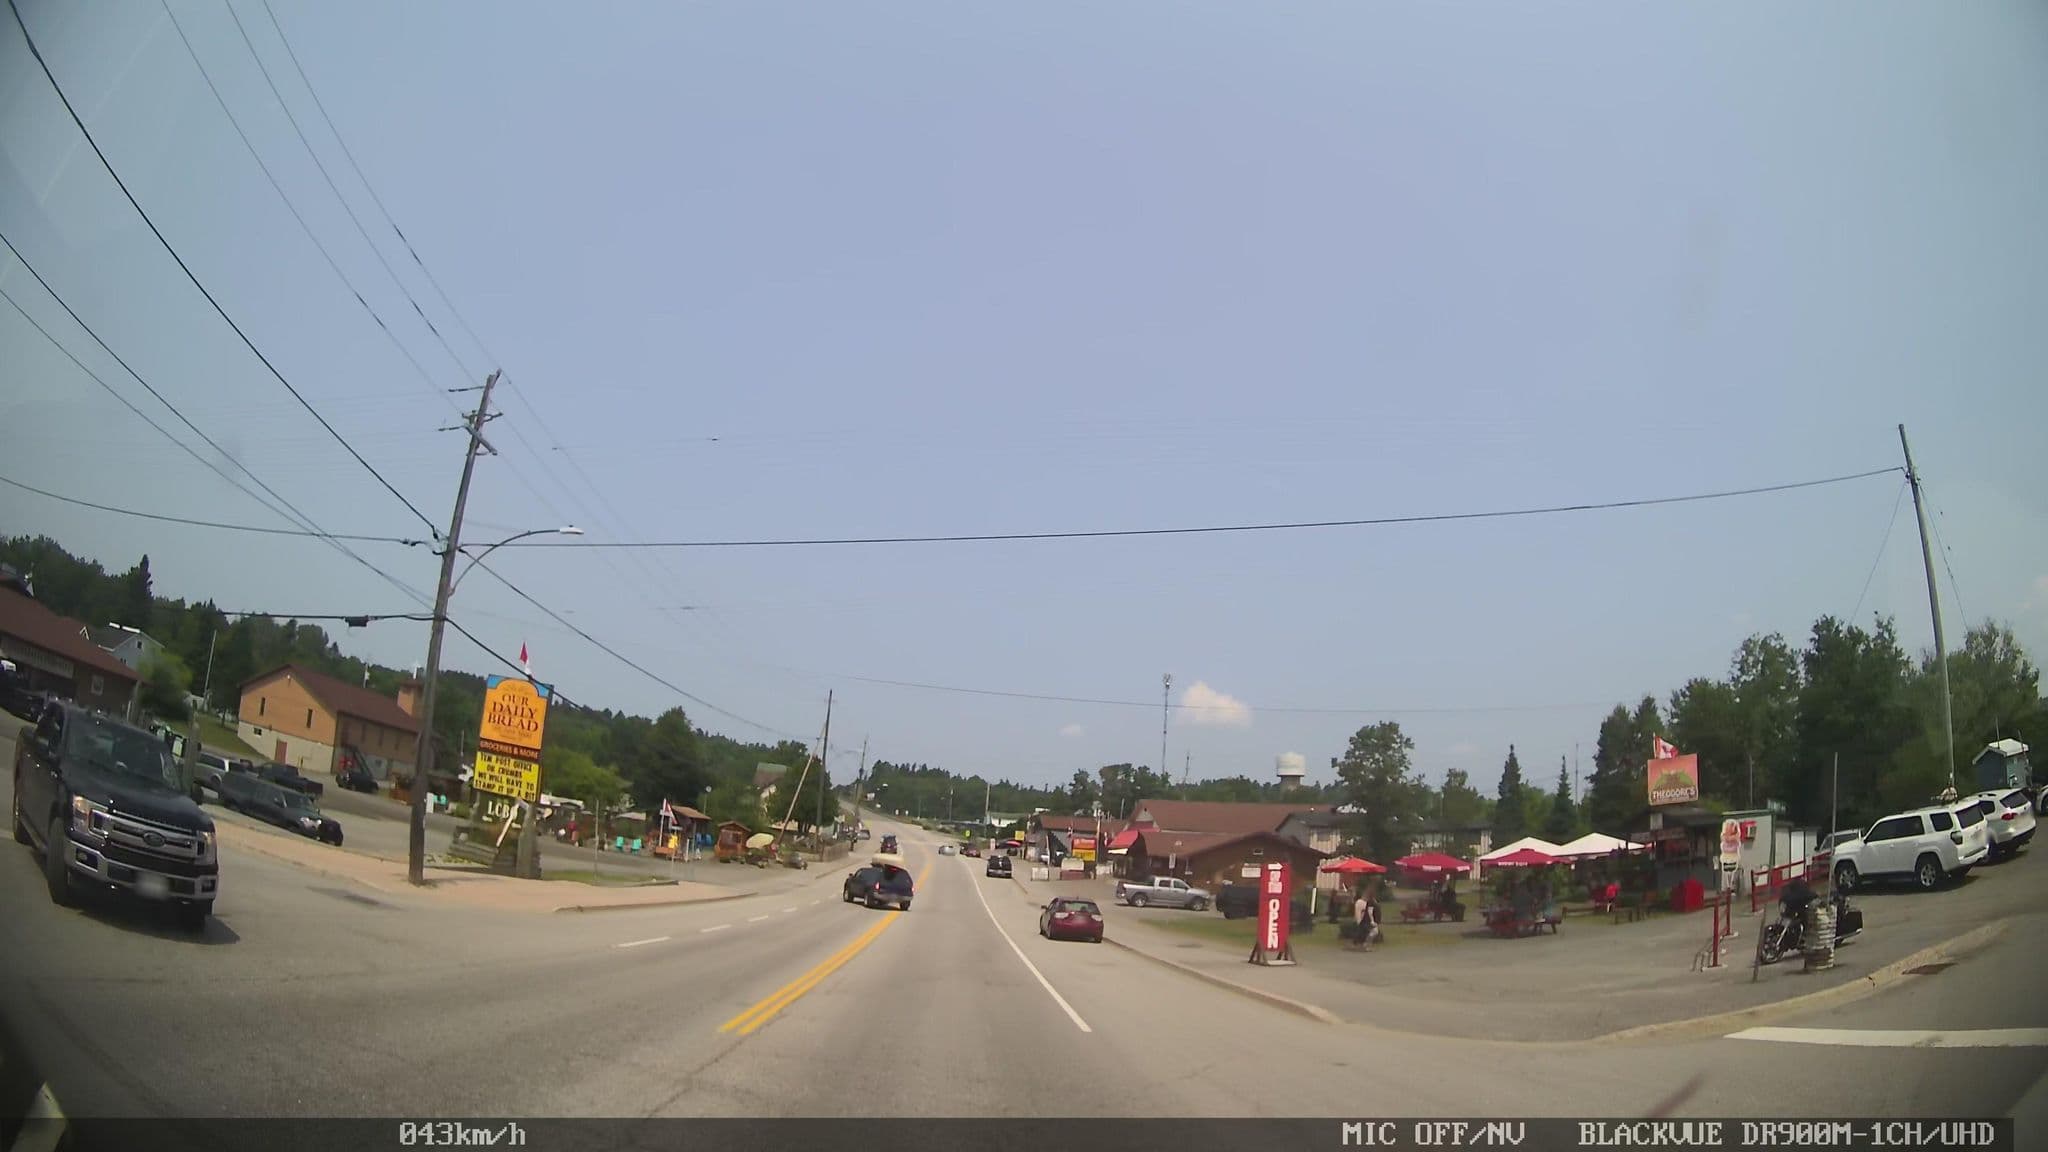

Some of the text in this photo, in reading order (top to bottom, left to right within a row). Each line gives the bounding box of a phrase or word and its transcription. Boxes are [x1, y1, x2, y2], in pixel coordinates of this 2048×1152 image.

[502, 694, 529, 706] OUR
[492, 701, 537, 719] DAILY
[487, 712, 539, 732] BREAD
[495, 756, 511, 767] POST
[475, 779, 496, 790] STAMP
[489, 774, 503, 785] WILL
[506, 777, 522, 788] HAVE
[526, 782, 535, 791] TO
[1267, 898, 1280, 949] OPEN
